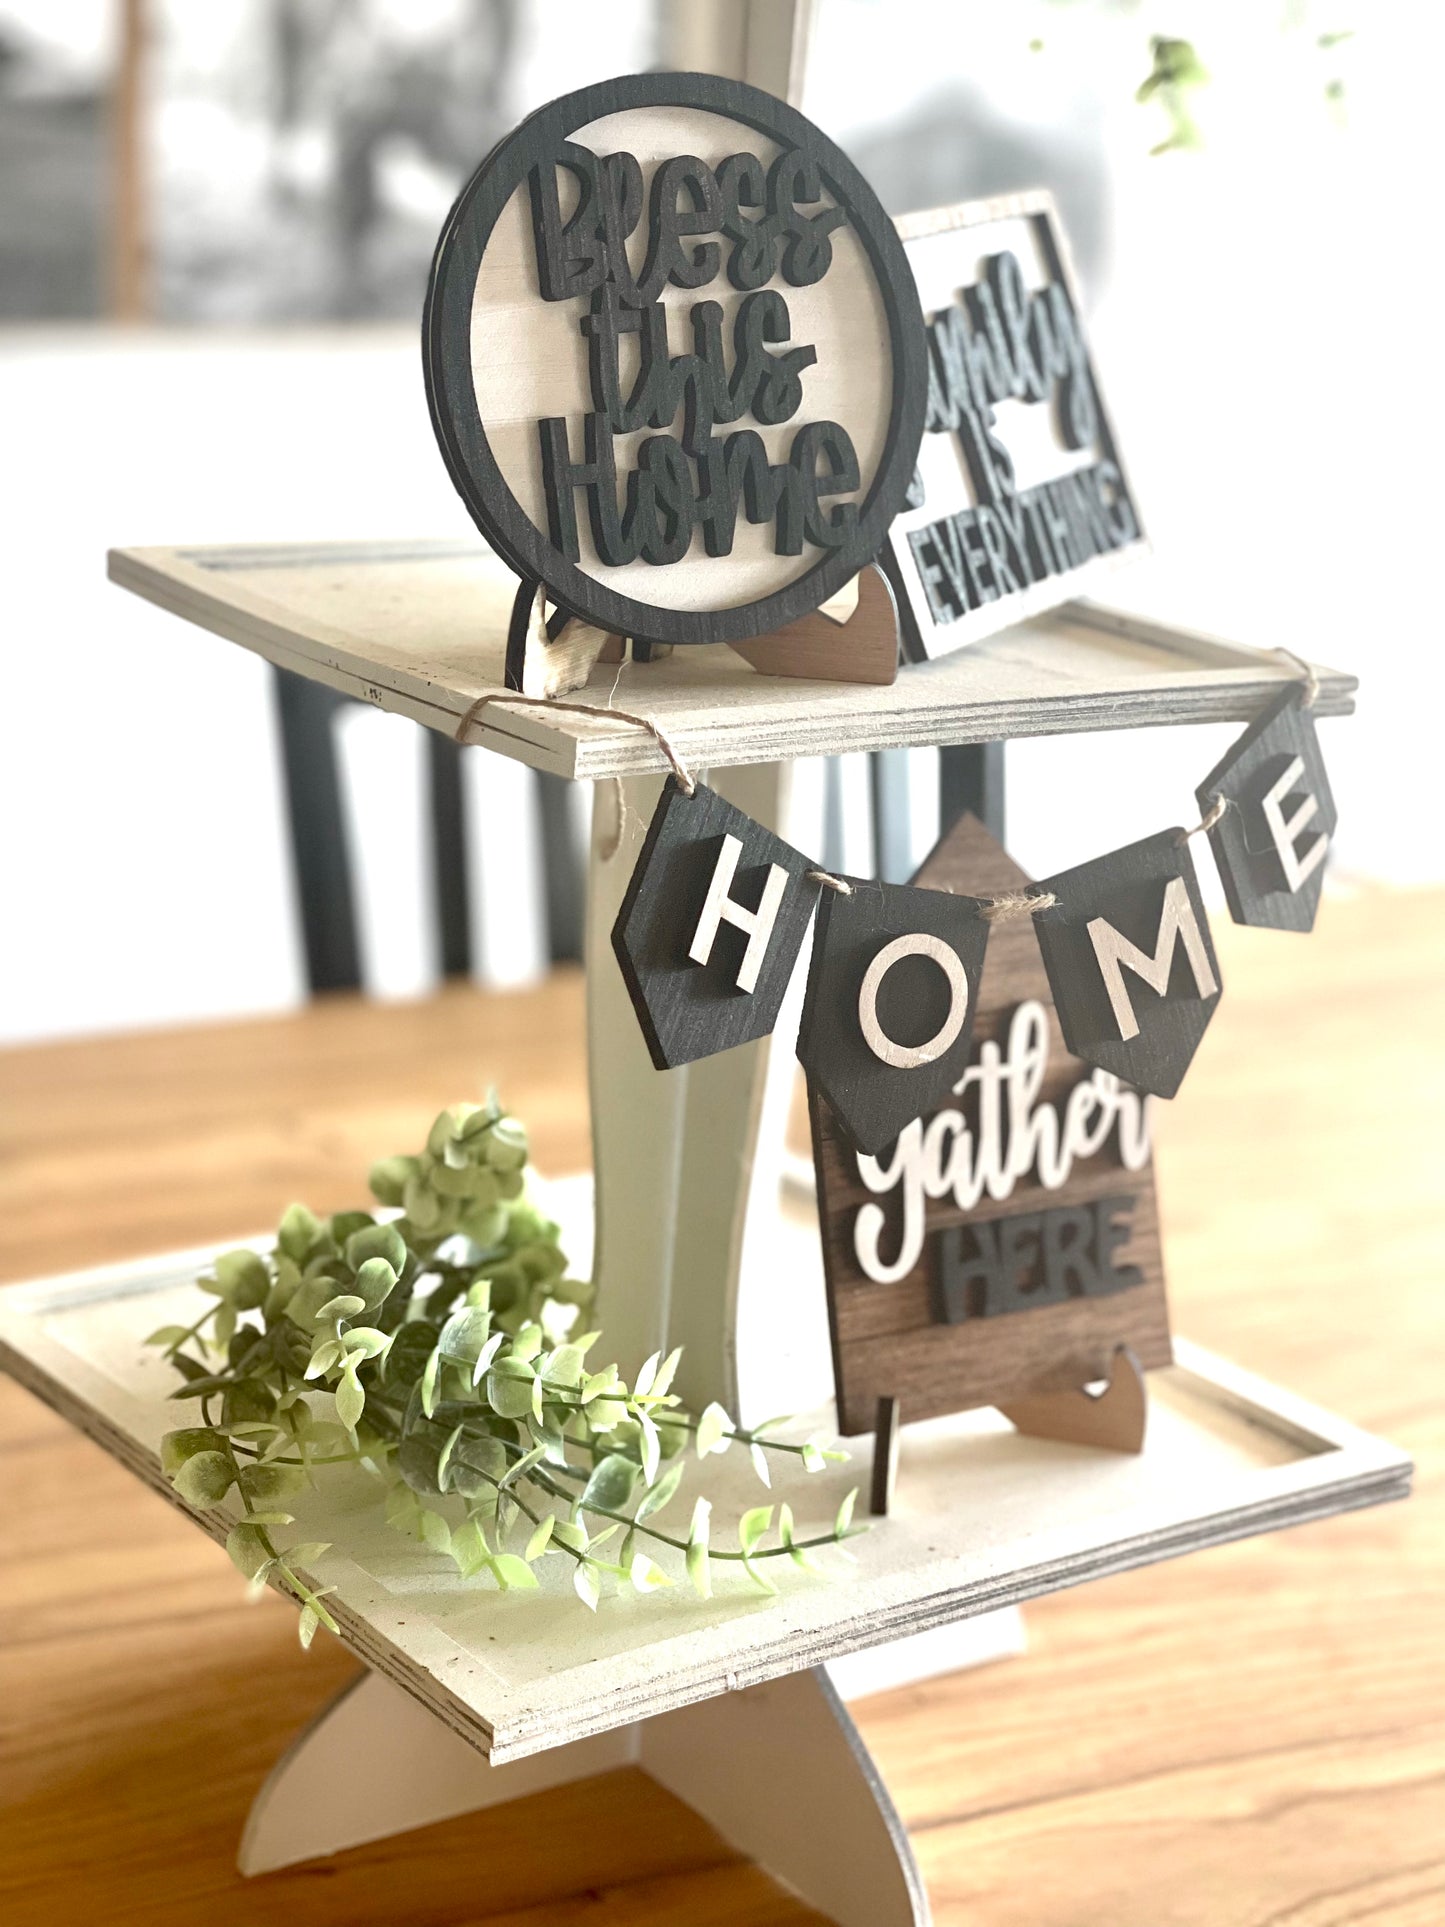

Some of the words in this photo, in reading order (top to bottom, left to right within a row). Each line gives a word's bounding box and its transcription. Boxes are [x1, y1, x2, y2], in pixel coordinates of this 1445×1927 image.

[528, 146, 848, 302] Bless
[581, 286, 818, 436] this
[926, 250, 1098, 452] mily
[537, 411, 861, 567] Home
[906, 462, 1138, 626] EVERYTHING
[688, 753, 1331, 1070] HOME
[853, 999, 1153, 1284] gather
[933, 1193, 1147, 1326] HERE
